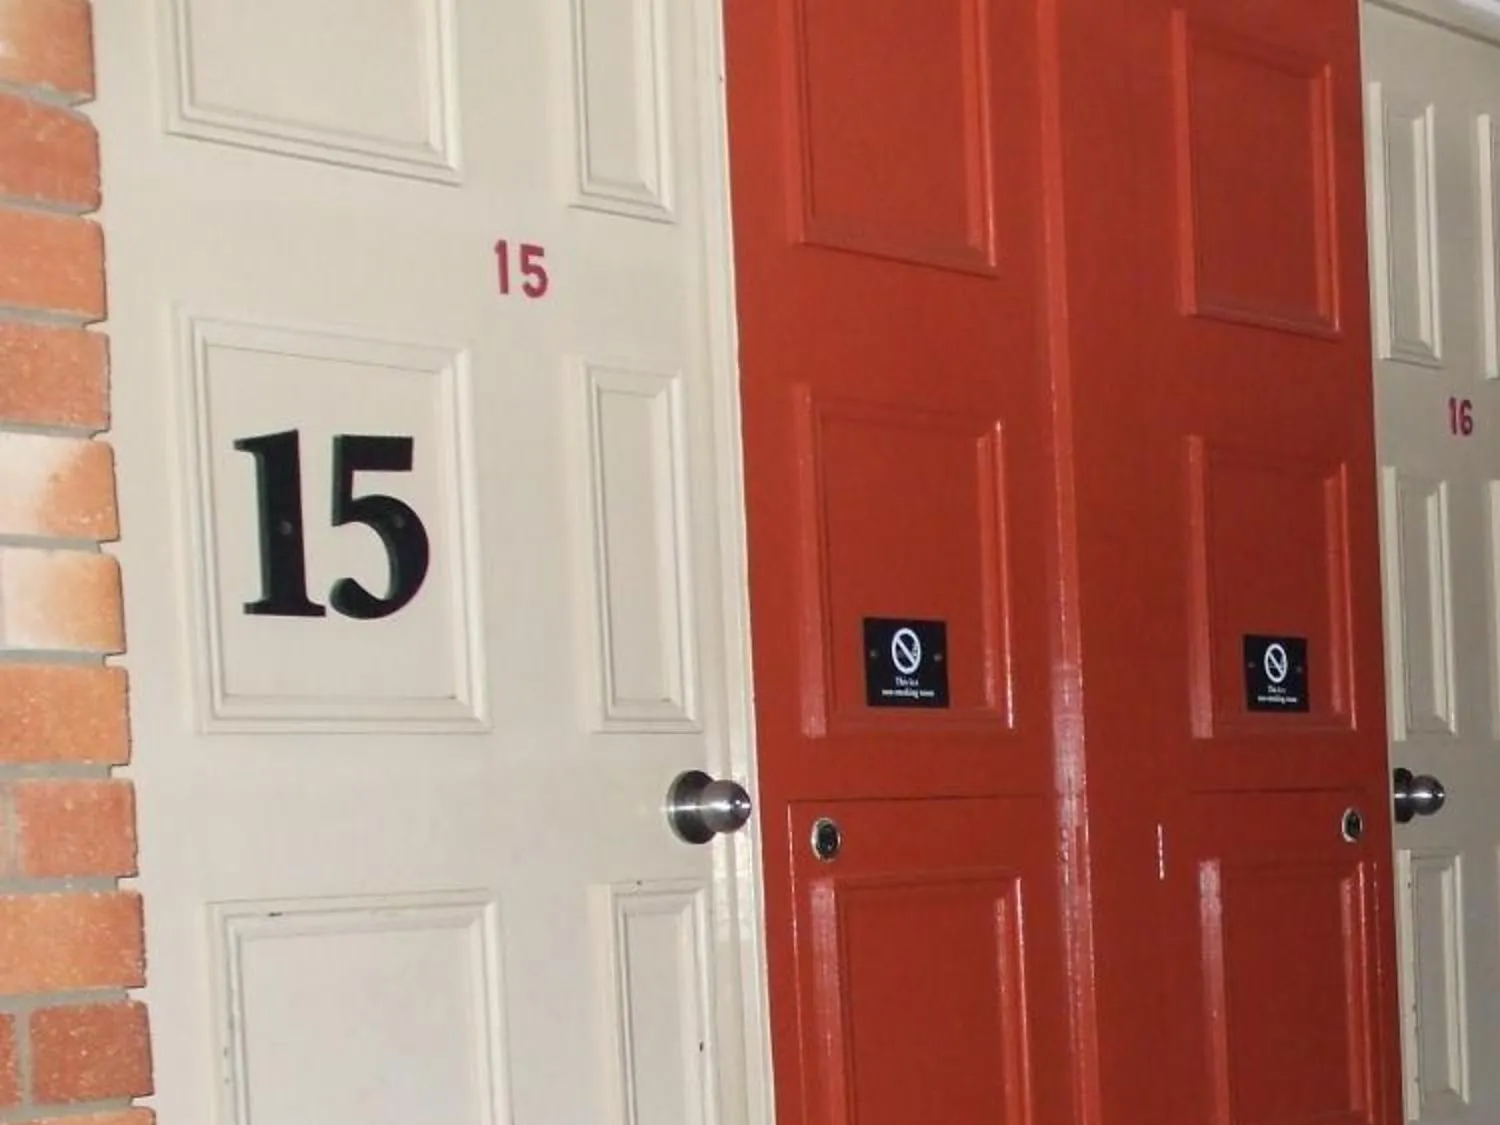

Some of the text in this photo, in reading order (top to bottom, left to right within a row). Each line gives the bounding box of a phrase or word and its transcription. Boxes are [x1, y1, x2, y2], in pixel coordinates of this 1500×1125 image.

[494, 239, 549, 299] 15
[1448, 397, 1473, 436] 16
[233, 429, 430, 621] 15
